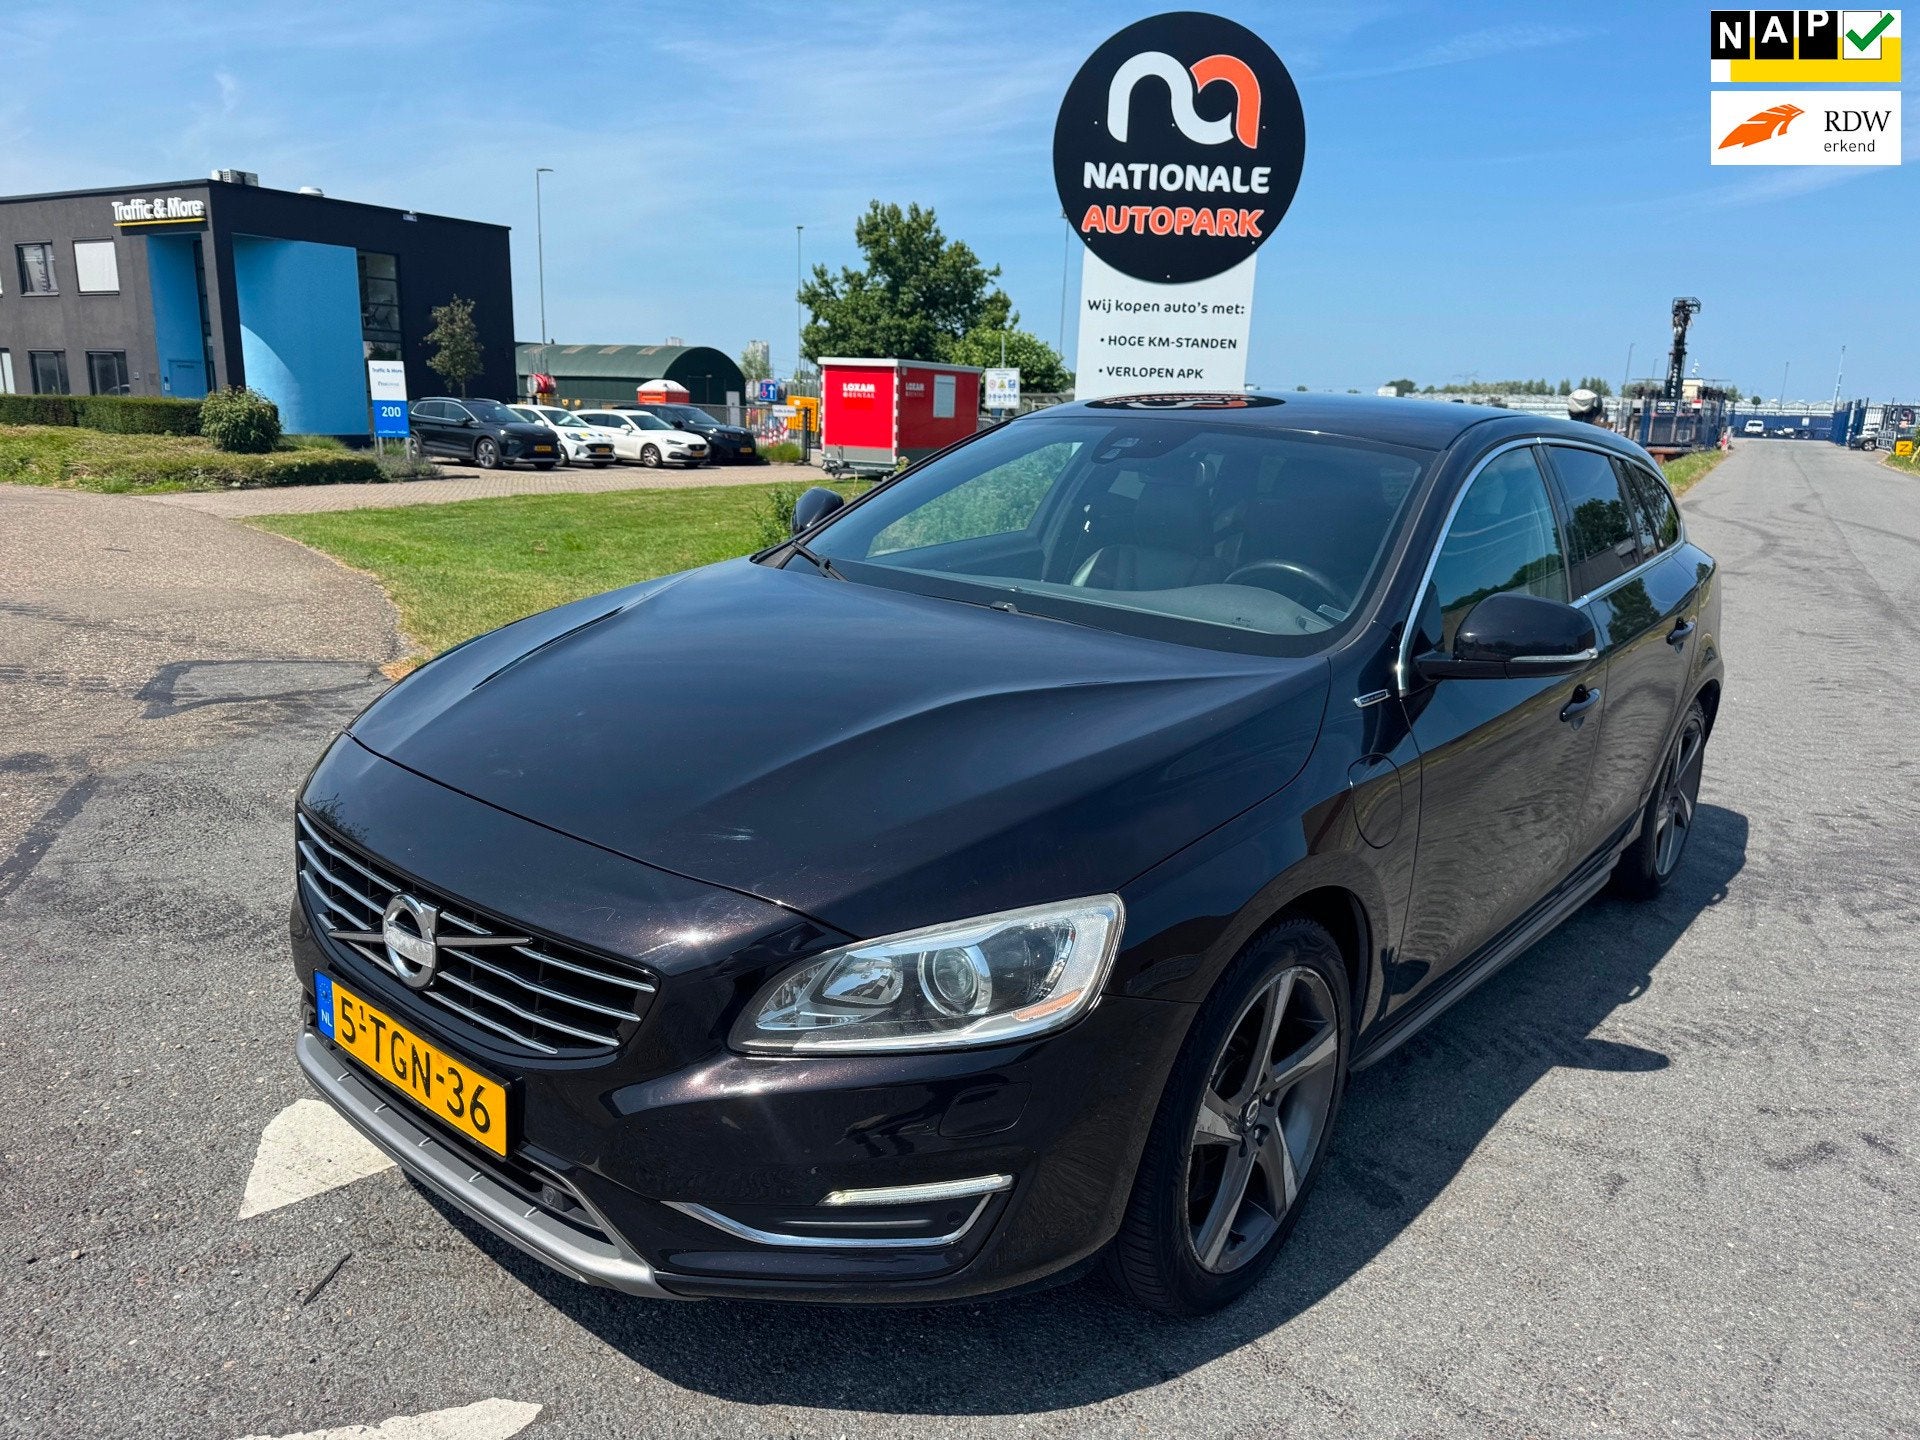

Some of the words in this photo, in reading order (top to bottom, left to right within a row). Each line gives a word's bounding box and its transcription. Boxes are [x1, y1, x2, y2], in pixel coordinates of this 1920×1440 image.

[1083, 161, 1272, 194] NATIONALE
[111, 198, 154, 221] Traffic
[153, 197, 168, 219] &
[167, 196, 206, 217] More
[1081, 204, 1265, 238] AUTOPARK
[1088, 299, 1112, 314] Wij
[1115, 299, 1160, 314] kopen
[1164, 301, 1208, 314] auto's
[1212, 303, 1245, 315] met:
[1108, 335, 1145, 347] HOGE
[1148, 336, 1237, 349] KM-STANDEN
[1106, 366, 1174, 378] VERLOPEN
[1177, 368, 1204, 379] APK
[842, 382, 876, 392] LOXAM
[381, 405, 402, 418] 200
[321, 1010, 333, 1029] NL
[340, 994, 492, 1135] 5-TGN-36
